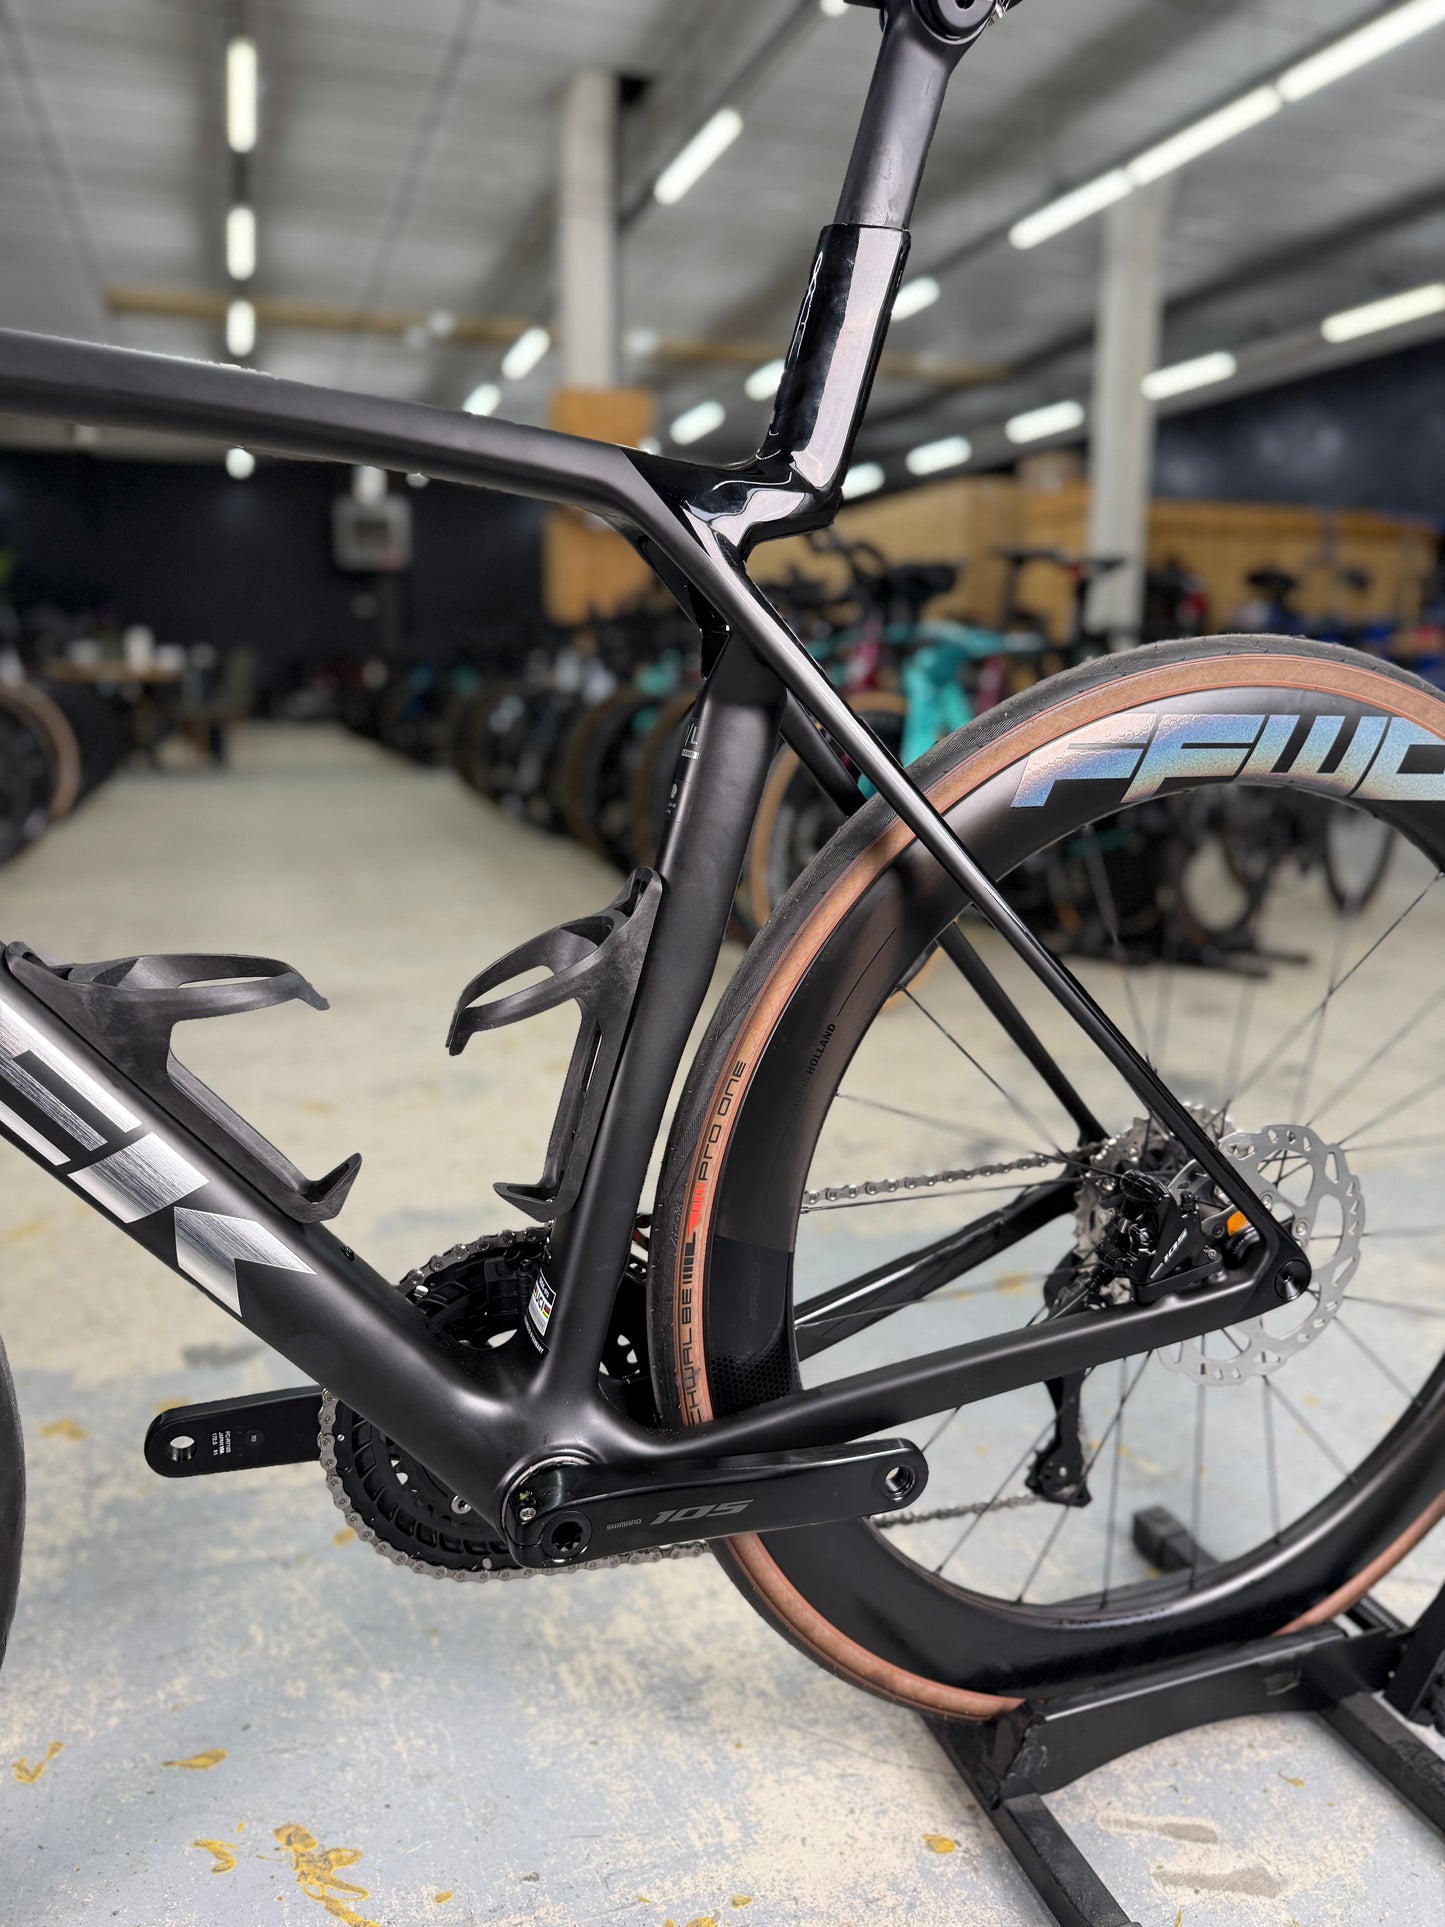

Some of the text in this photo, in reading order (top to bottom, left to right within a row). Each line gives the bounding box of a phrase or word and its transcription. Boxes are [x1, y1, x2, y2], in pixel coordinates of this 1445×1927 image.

[805, 1023, 836, 1076] HOLLAND
[717, 1060, 747, 1117] ONE
[606, 1499, 755, 1531] SHIMANO 105
